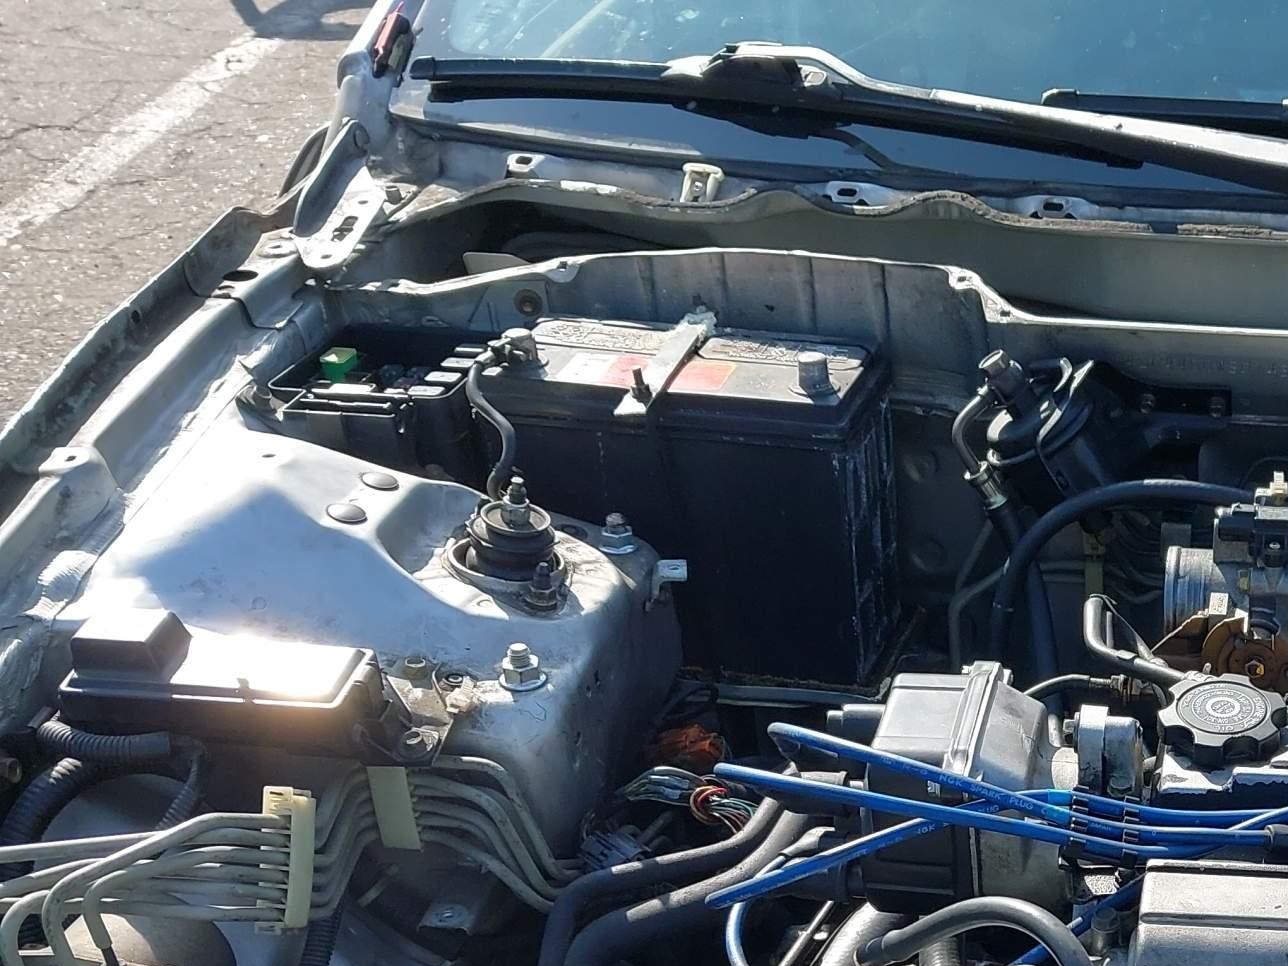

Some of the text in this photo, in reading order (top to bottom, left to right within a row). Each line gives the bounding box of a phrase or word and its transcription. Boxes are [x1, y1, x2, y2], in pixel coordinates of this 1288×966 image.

[938, 774, 964, 787] NGK
[970, 783, 1005, 801] SPARK
[1009, 797, 1034, 811] PLUG
